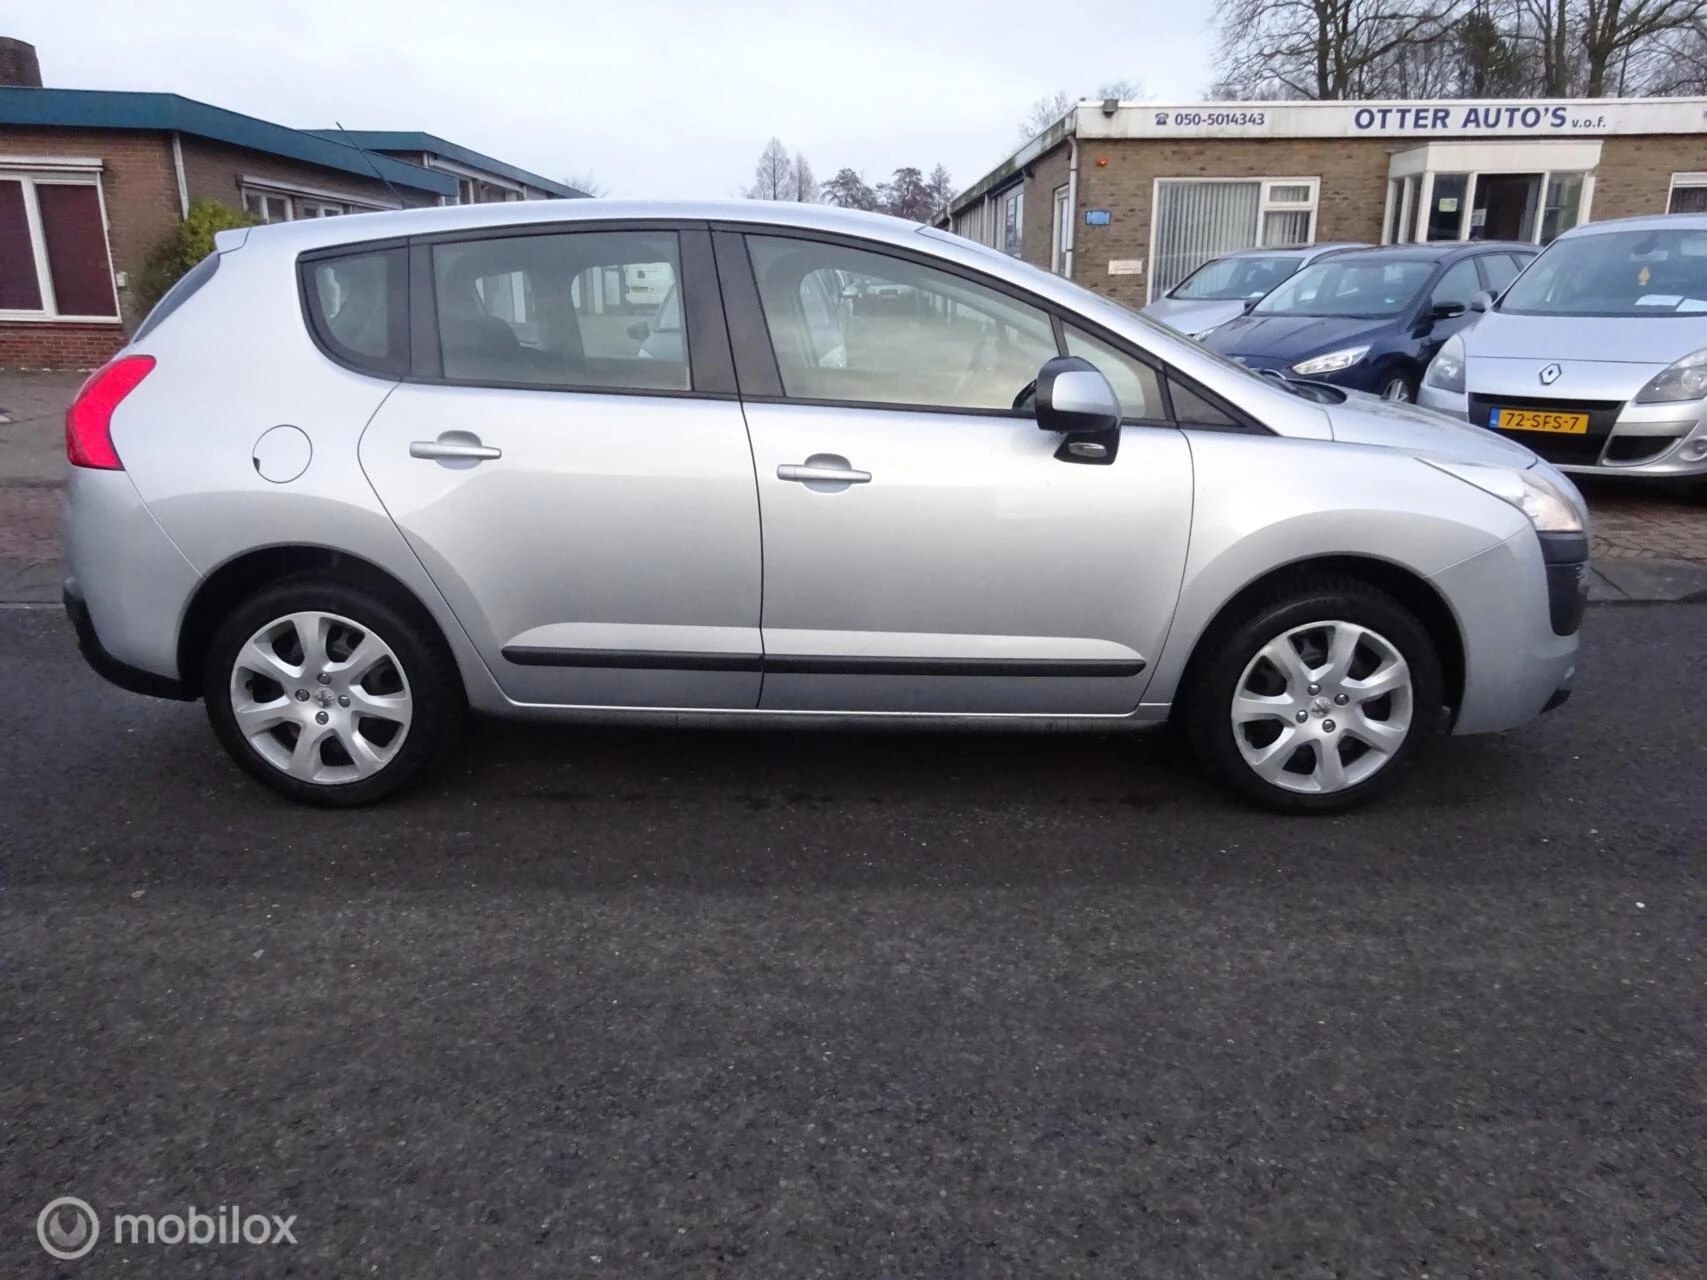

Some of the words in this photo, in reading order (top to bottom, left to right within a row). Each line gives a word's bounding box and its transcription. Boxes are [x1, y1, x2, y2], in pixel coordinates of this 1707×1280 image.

[1174, 112, 1265, 126] 050-5014343
[1354, 108, 1451, 130] OTTER
[1461, 106, 1567, 129] AUTO'S
[1571, 116, 1607, 128] v.o.f.
[1505, 412, 1580, 430] 72-SFS-7
